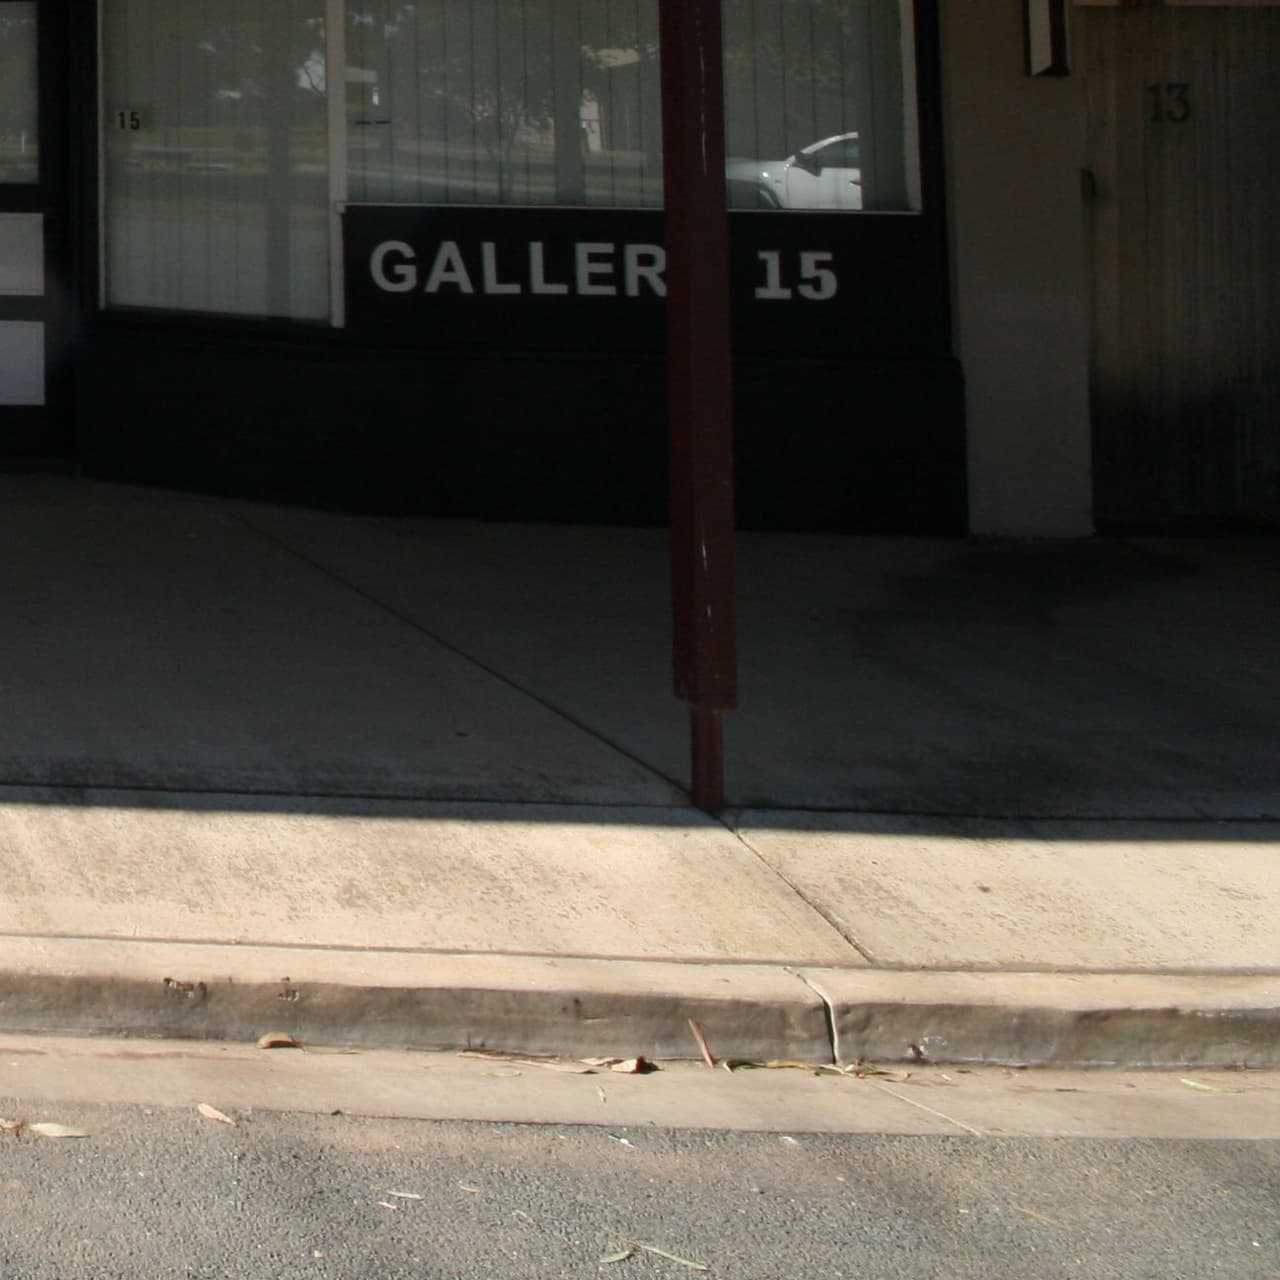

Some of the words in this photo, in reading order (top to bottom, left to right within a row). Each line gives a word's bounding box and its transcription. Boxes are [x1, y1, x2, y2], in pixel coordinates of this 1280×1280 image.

[118, 111, 140, 130] 15
[1146, 82, 1191, 122] 13
[368, 240, 670, 297] GALLER
[754, 250, 839, 301] 15
